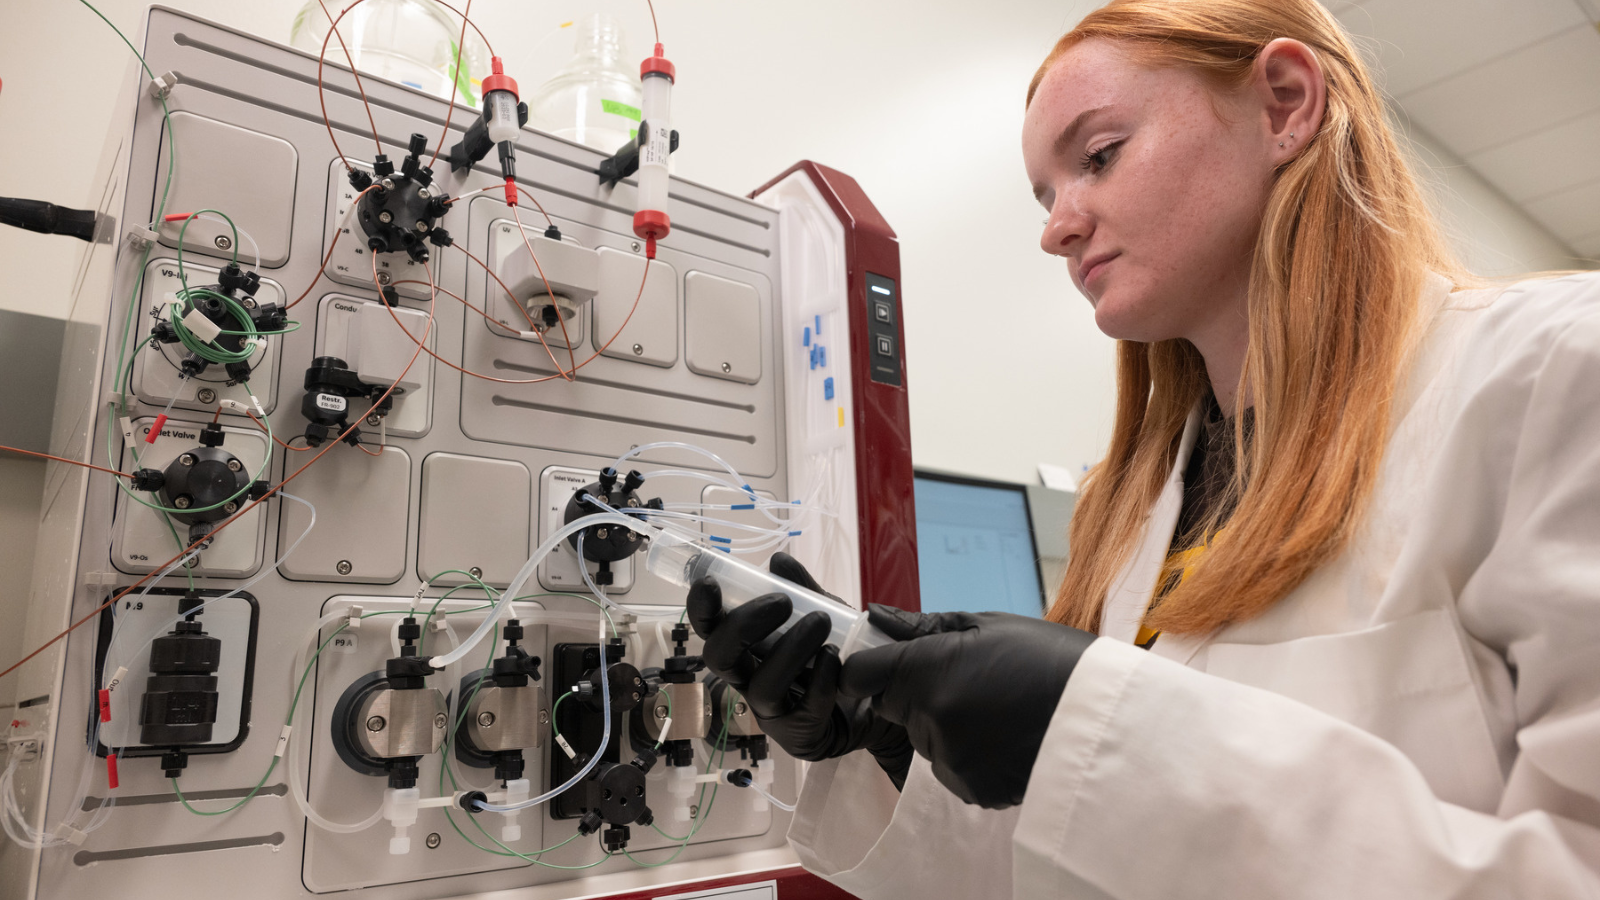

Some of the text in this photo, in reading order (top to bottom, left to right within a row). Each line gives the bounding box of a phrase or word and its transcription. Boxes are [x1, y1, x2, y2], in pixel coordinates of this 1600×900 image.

[321, 395, 342, 404] Restr.
[172, 430, 196, 440] Valve
[335, 639, 345, 647] P9
[109, 679, 120, 692] Out
